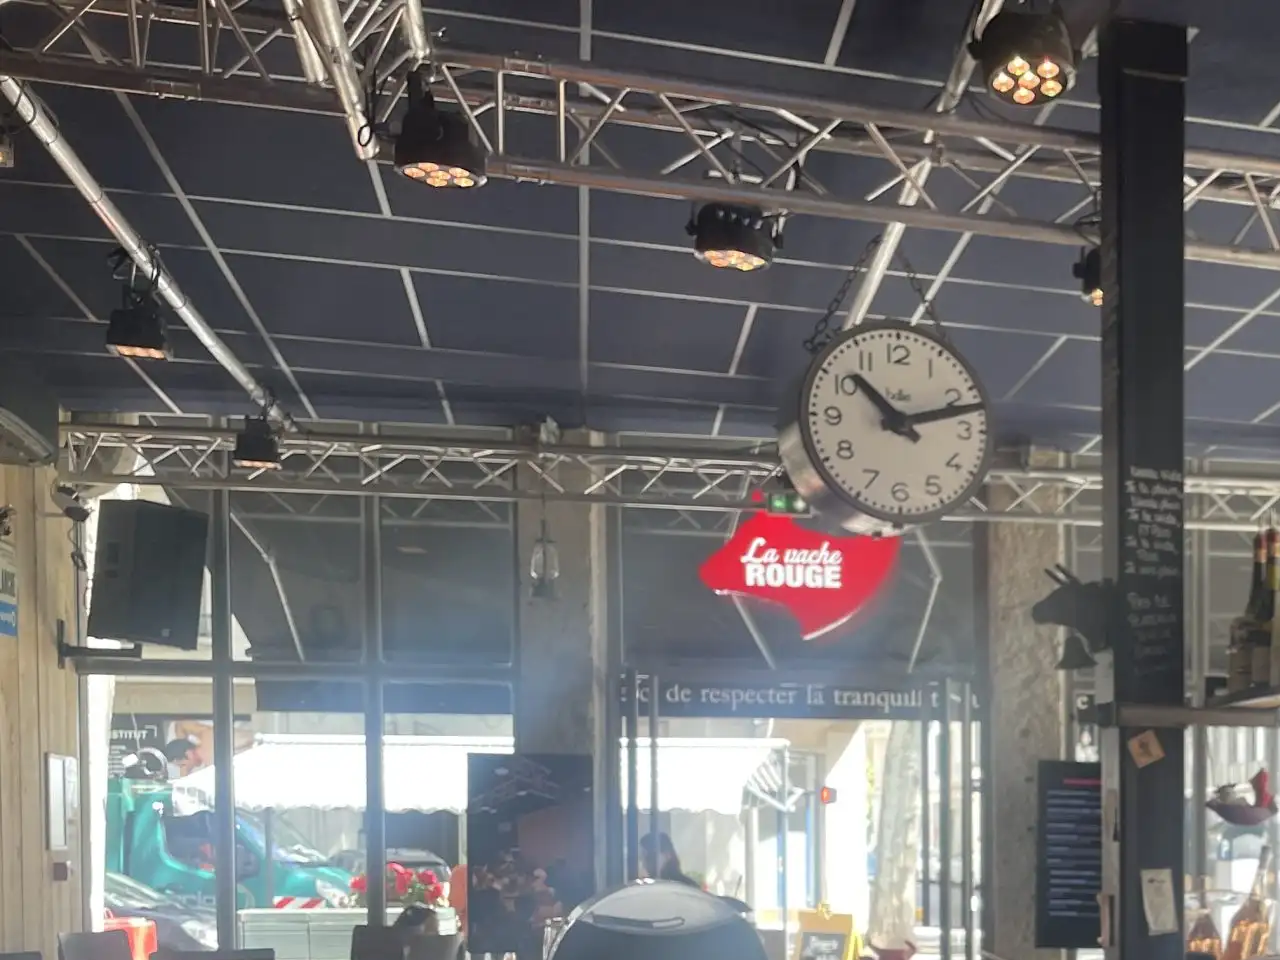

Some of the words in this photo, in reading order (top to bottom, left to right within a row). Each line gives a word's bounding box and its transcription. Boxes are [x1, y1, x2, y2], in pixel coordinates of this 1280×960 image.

[859, 351, 873, 372] 11
[887, 343, 911, 365] 12
[928, 358, 933, 379] 1
[834, 373, 858, 396] 10
[944, 388, 962, 407] 2
[824, 406, 842, 426] 9
[957, 420, 972, 441] 3
[836, 439, 855, 460] 8
[945, 452, 963, 471] 4
[862, 468, 880, 490] 7
[924, 474, 942, 496] 5
[891, 482, 909, 502] 6
[740, 536, 780, 563] La
[783, 540, 843, 565] vache
[744, 563, 843, 589] ROUGE
[665, 683, 692, 703] de
[701, 686, 797, 712] respecter
[806, 683, 824, 706] la
[833, 688, 941, 714] tranquillt
